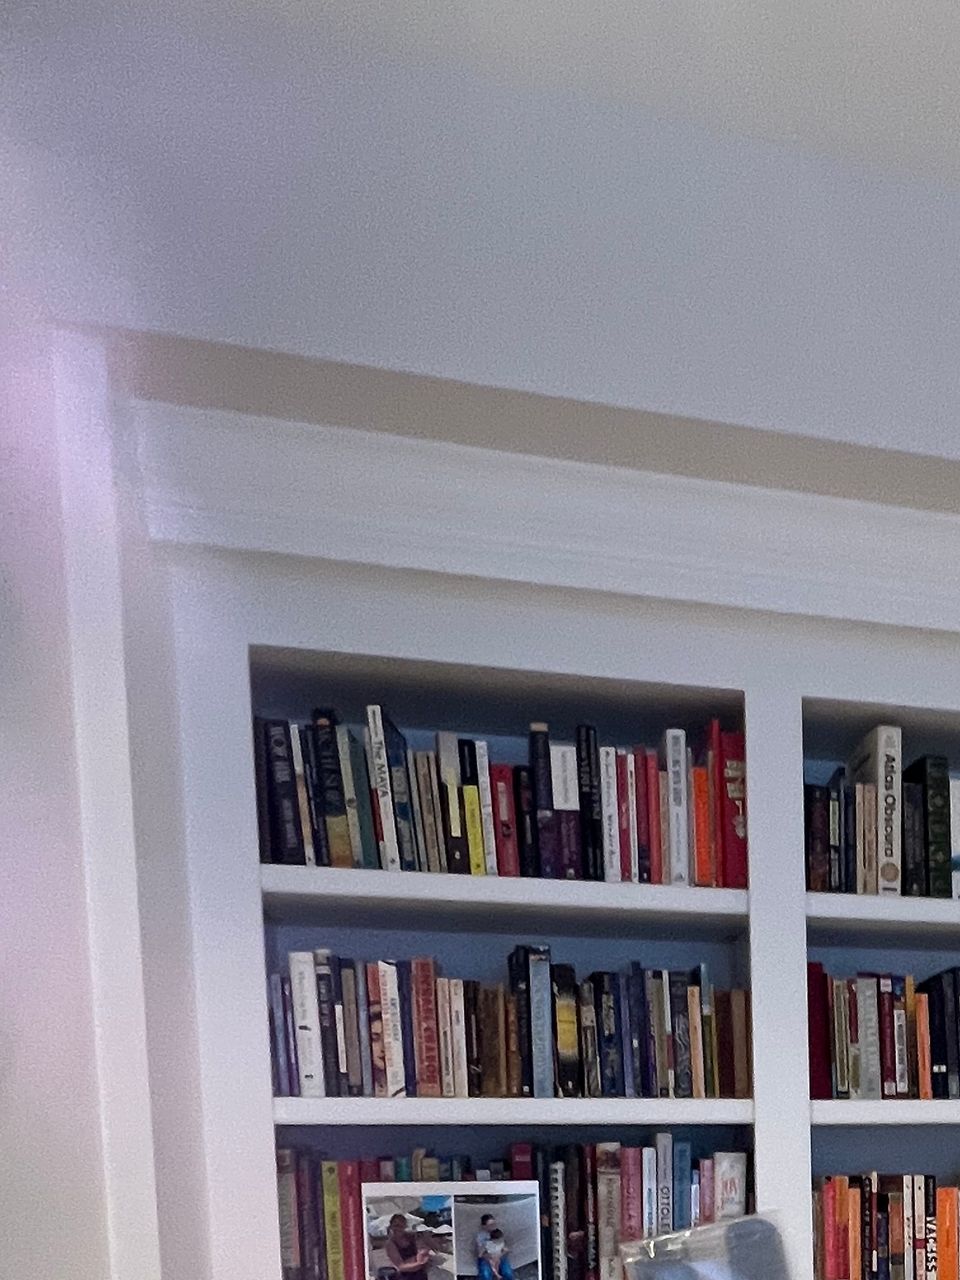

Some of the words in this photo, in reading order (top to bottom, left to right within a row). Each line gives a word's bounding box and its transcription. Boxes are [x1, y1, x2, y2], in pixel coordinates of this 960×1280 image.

[374, 740, 383, 760] The
[377, 763, 389, 798] MAYA
[885, 754, 896, 791] Atlas
[884, 794, 896, 858] Obscura
